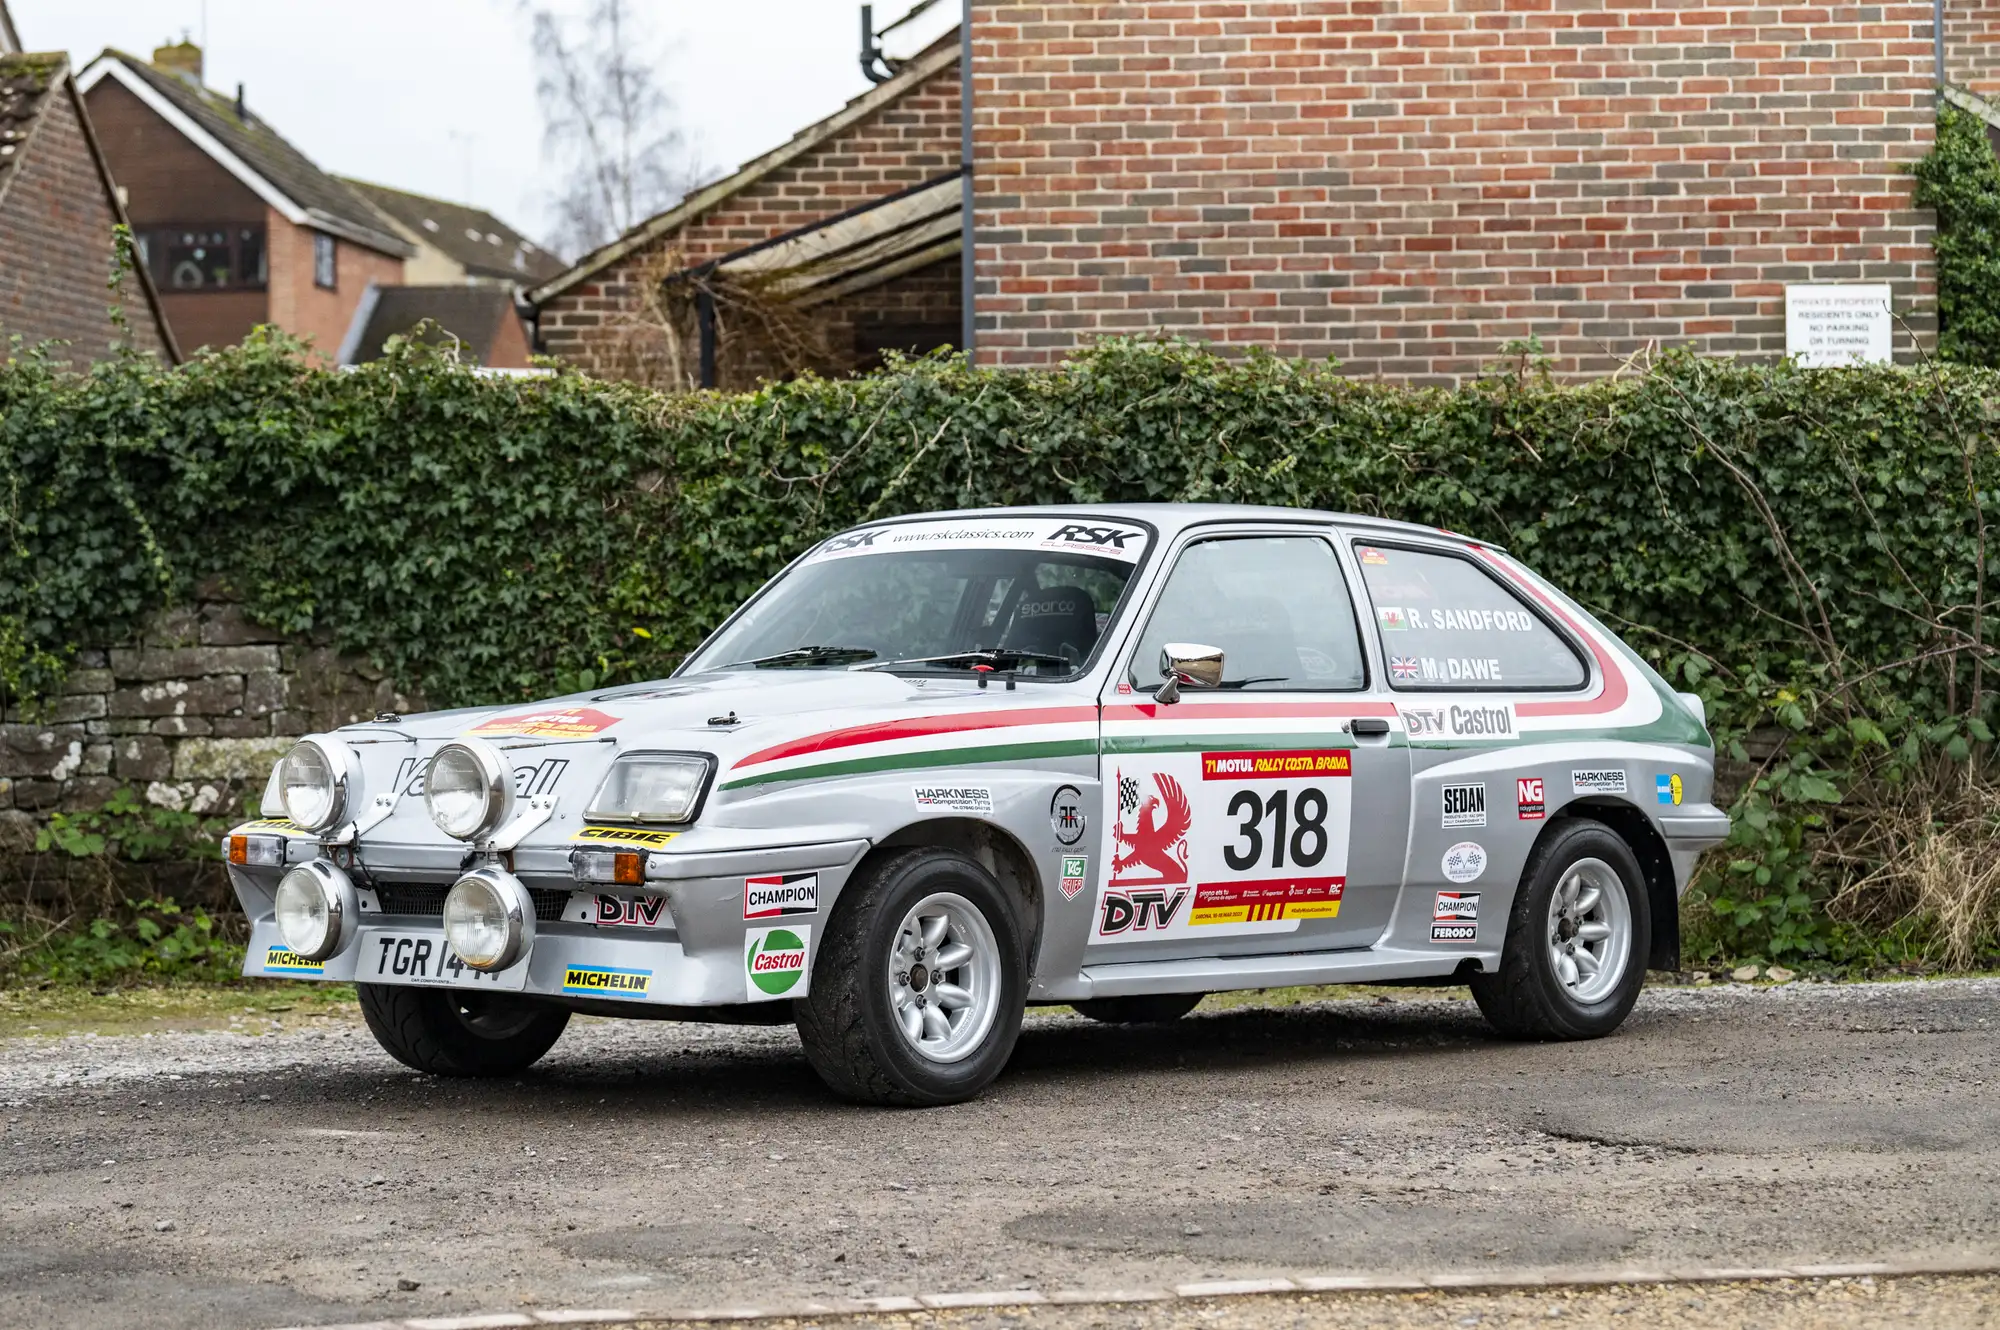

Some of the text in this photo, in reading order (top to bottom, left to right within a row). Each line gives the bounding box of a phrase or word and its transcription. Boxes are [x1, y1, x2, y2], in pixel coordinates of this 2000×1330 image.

[1792, 297, 1831, 306] PRIVATE
[1809, 324, 1869, 332] NO PARKING
[1809, 337, 1869, 345] OR TURNING
[892, 528, 1035, 543] www.rskclassics.com
[1047, 524, 1145, 549] RSK
[1040, 541, 1123, 555] CLASSICS
[1020, 600, 1076, 616] sparco
[1406, 607, 1533, 632] R. SANDFORD
[1420, 657, 1502, 681] M. DAWE
[1401, 705, 1512, 736] DTV Castrol
[1254, 757, 1284, 772] RALLY
[1285, 757, 1315, 771] COSTA
[1315, 756, 1348, 770] BRAVA
[392, 757, 571, 799] Vaall
[1574, 772, 1624, 781] HARKNESS
[915, 788, 990, 799] HARKNESS
[1518, 780, 1543, 803] NG
[932, 798, 991, 807] Competition Tyres
[1444, 787, 1485, 814] SEDAN
[579, 828, 671, 844] CIBIE
[1223, 787, 1328, 871] 318
[1066, 860, 1082, 876] TAG
[749, 886, 815, 906] CHAMPION
[1063, 879, 1083, 896] HEUER
[594, 894, 670, 926] DTV
[1100, 887, 1190, 936] DTV
[1437, 900, 1478, 912] CHAMPION
[1433, 927, 1474, 939] FERODO
[377, 937, 432, 977] TGR
[755, 952, 805, 971] Castrol
[567, 971, 647, 990] MICHELIN
